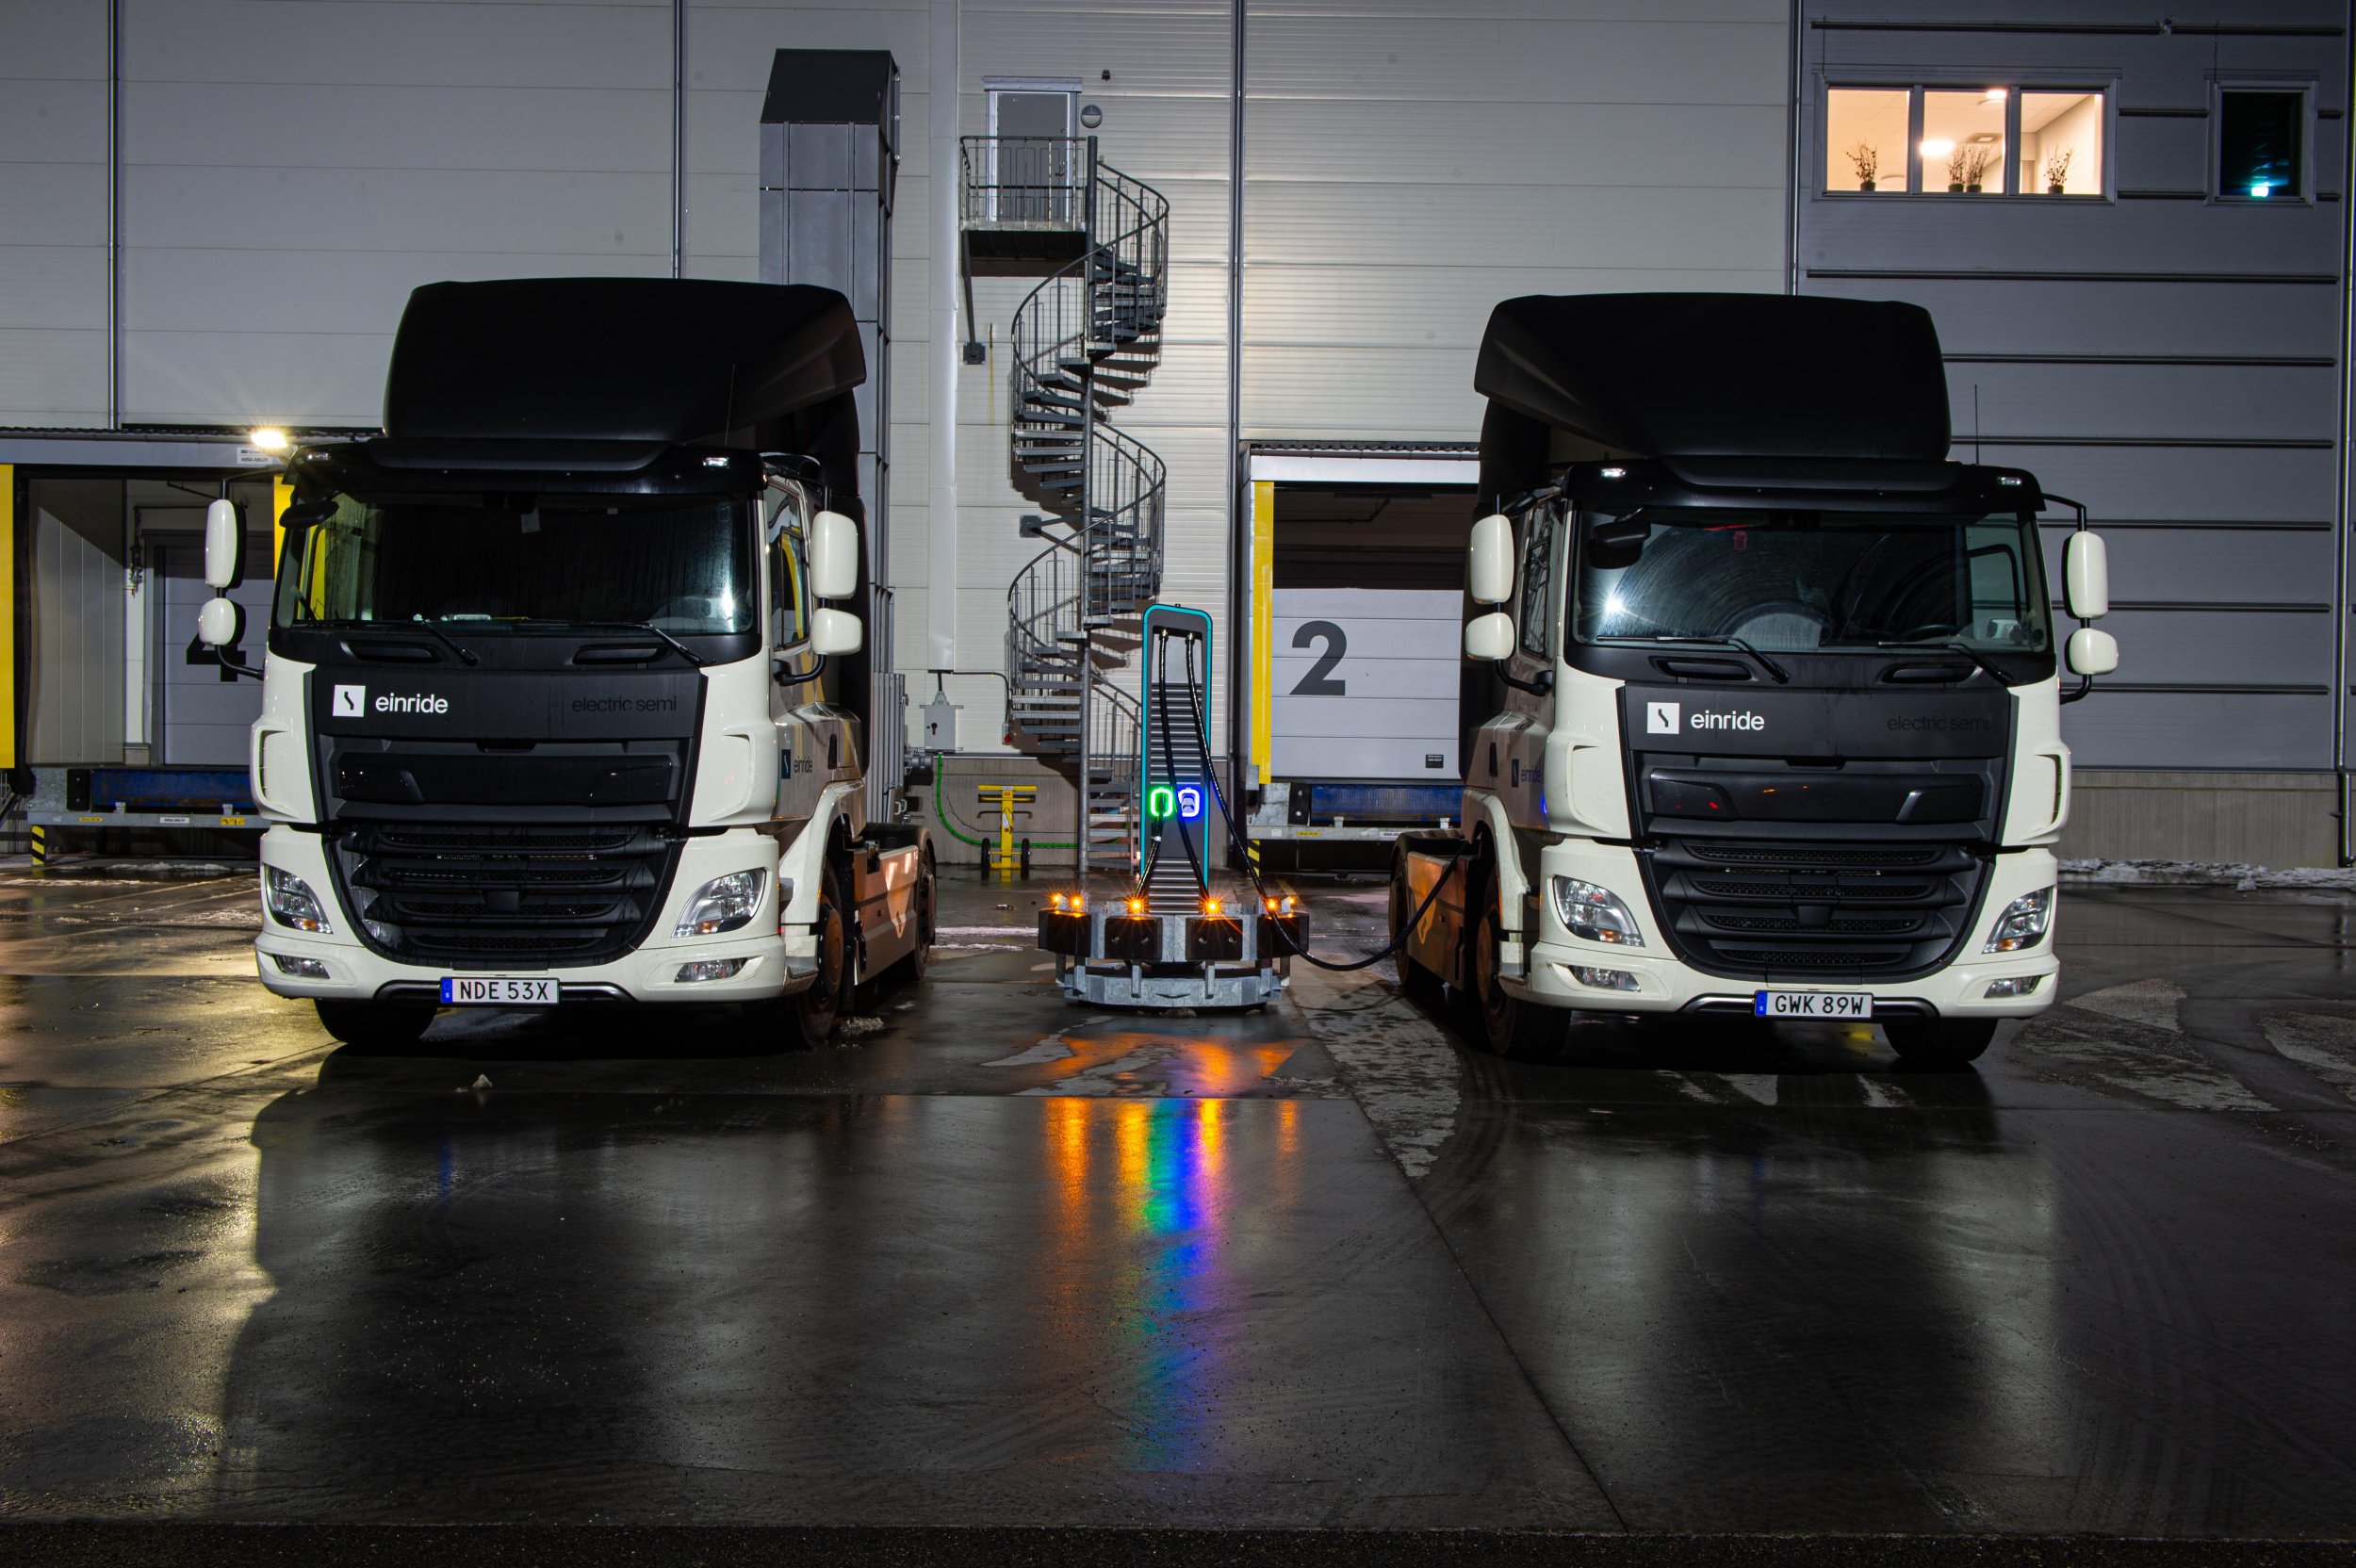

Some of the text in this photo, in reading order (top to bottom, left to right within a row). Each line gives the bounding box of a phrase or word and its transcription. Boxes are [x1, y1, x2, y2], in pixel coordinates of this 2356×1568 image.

[1288, 620, 1348, 696] 2
[375, 692, 449, 714] einride
[572, 695, 677, 712] electric semi
[1691, 710, 1765, 731] einride
[1887, 714, 1989, 731] electric semi
[794, 755, 813, 774] einride
[460, 981, 548, 1001] NDE 53X
[1775, 995, 1864, 1015] GWK 89W
